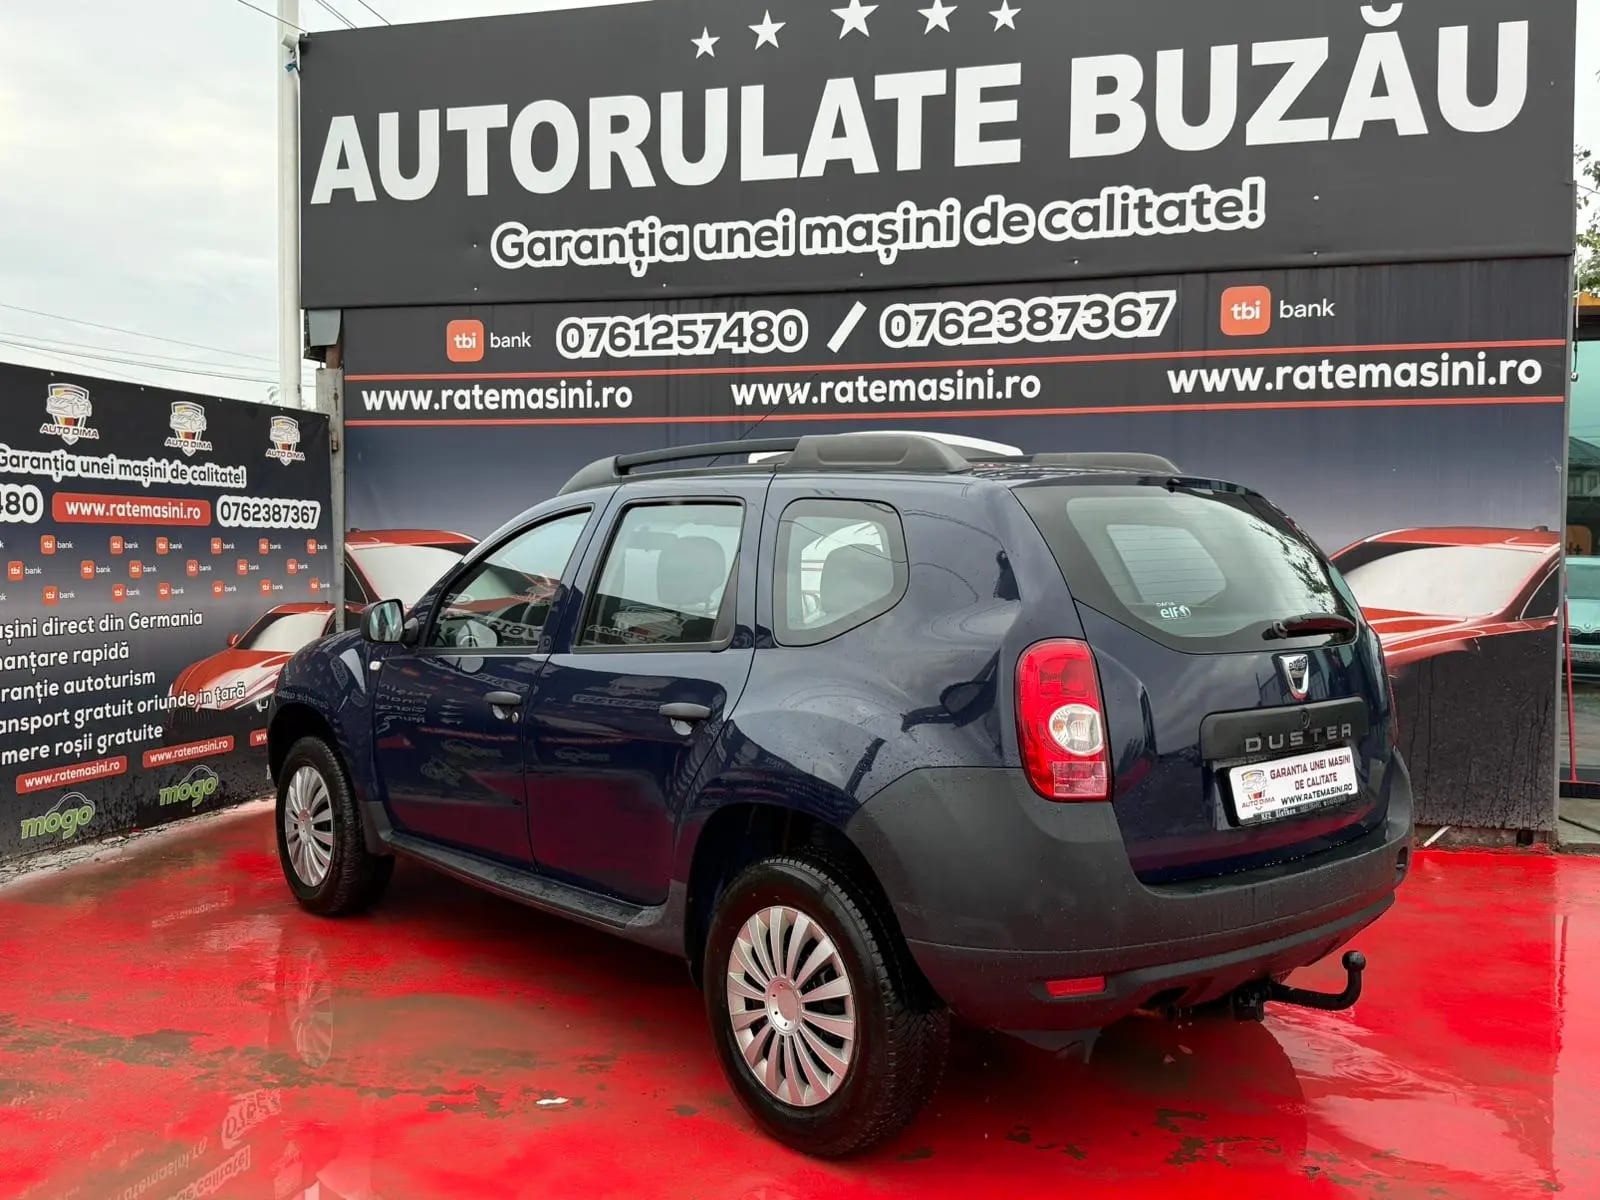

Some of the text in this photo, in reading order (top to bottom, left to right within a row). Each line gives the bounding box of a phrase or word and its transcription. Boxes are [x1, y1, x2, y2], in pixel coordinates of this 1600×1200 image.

[310, 2, 1528, 205] AUTORULATE BUZĂU
[493, 182, 1261, 274] Garanția unei mașini de calitate!
[1230, 299, 1336, 320] tbi bank
[560, 313, 804, 355] 0761257480
[883, 295, 1173, 345] 0762387367
[453, 332, 532, 349] tbi bank
[1166, 351, 1542, 394] www.ratemasini.ro
[362, 381, 633, 411] www.ratemasini.ro
[731, 369, 1041, 406] www.ratemasini.ro
[41, 424, 99, 438] AUTO DIMA
[165, 438, 212, 450] AUTO DIMA
[266, 450, 284, 458] AUTO
[80, 457, 115, 476] unei
[170, 463, 188, 480] de
[191, 466, 245, 485] calitate!
[0, 491, 38, 516] 80
[65, 501, 201, 520] www.ratemasini.ro
[219, 501, 318, 525] 0762387367
[44, 541, 73, 549] tbi bank
[143, 565, 156, 573] bank
[59, 591, 75, 599] bank
[42, 616, 95, 636] direct
[99, 614, 125, 631] din
[128, 610, 203, 629] Germania
[1160, 606, 1178, 618] elf
[73, 642, 129, 666] rapidă
[64, 670, 155, 694] autoturism
[74, 699, 134, 729] gratuit
[137, 691, 196, 713] oriunde
[199, 689, 212, 704] in
[1, 724, 163, 766] mere roșii gratuite
[1245, 723, 1352, 753] DUSTER
[150, 740, 228, 763] www.ratemasini.ro
[25, 762, 120, 788] www.ratemasini.ro
[1270, 754, 1351, 780] GARANTIA UNEI MASINI
[160, 777, 218, 807] mogo
[1294, 772, 1338, 790] DE CALITATE
[1280, 783, 1353, 805] WWW.RATEMASINI.RO
[21, 805, 94, 839] mogo
